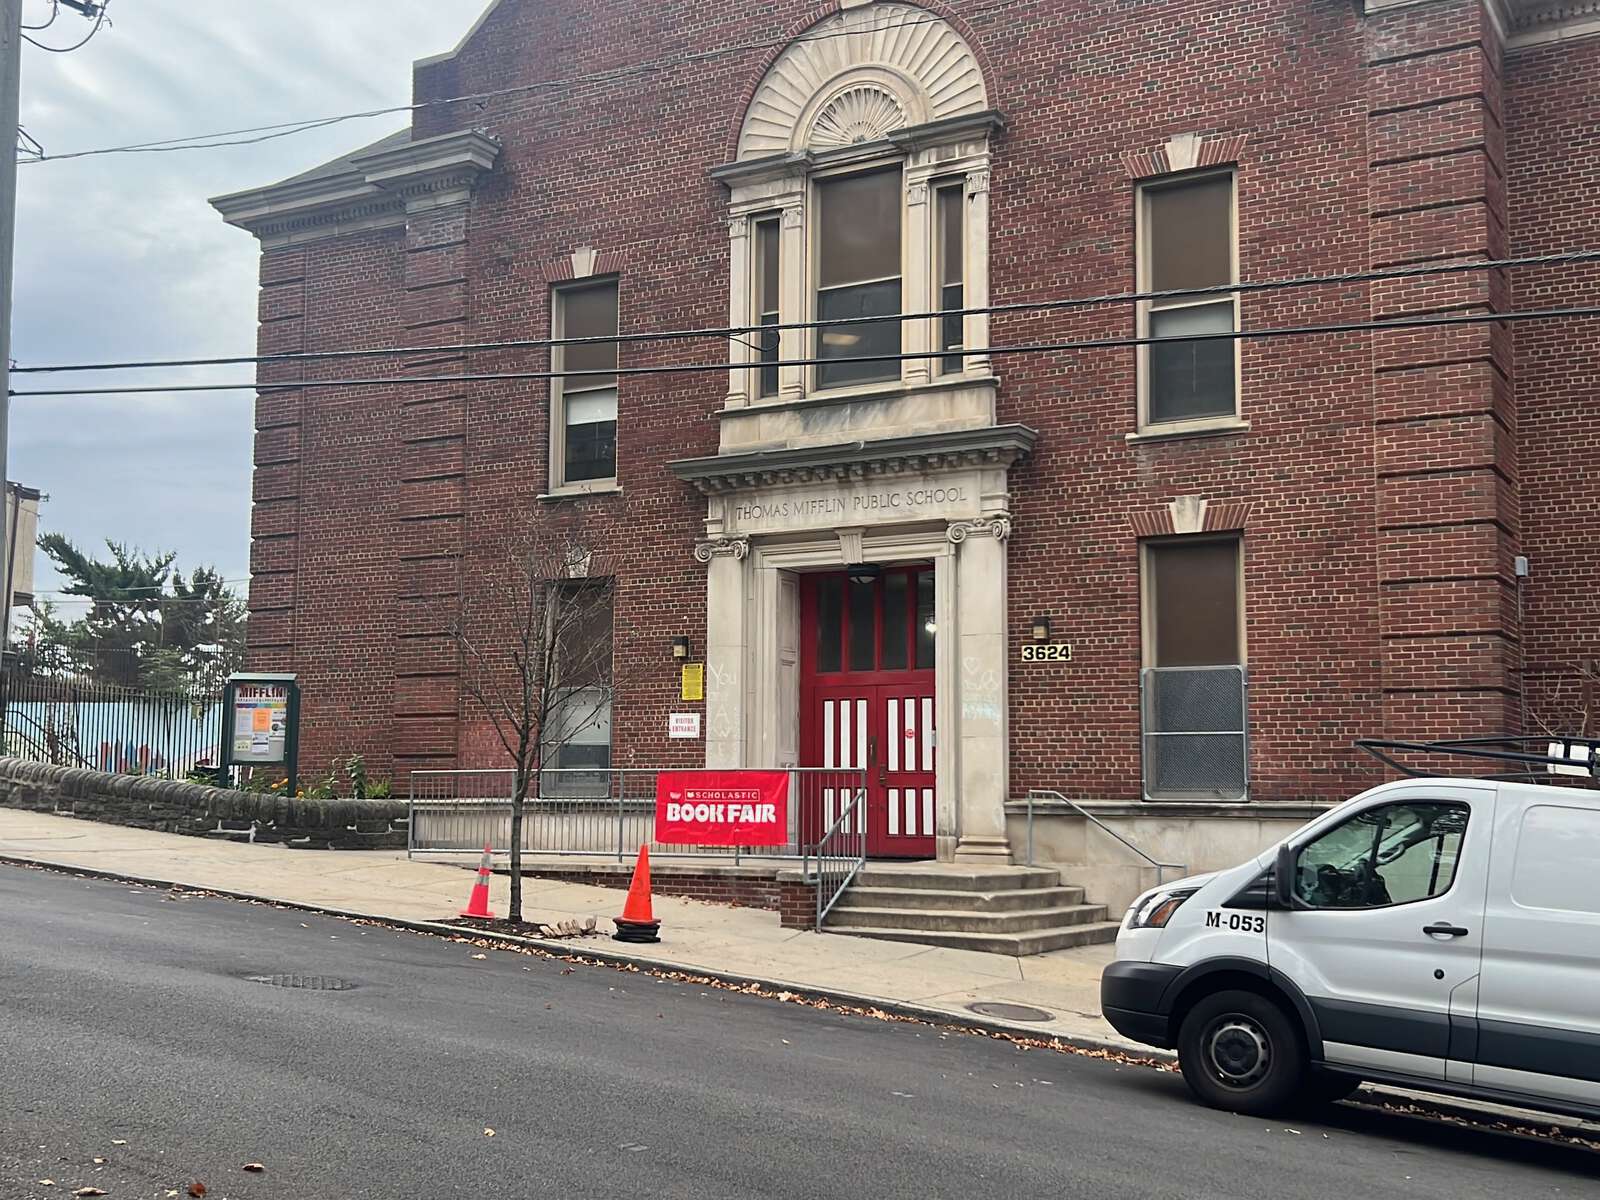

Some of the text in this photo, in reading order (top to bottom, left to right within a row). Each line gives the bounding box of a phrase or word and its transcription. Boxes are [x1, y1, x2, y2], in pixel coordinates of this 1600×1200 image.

[736, 487, 967, 520] THOMAS MIFFLIN PUBLIC SCHOOL
[1023, 645, 1070, 660] 3624
[239, 687, 283, 698] MIFFLIN
[695, 791, 758, 800] SCHOLASTIC
[666, 803, 776, 823] BOOK FAIR
[1205, 911, 1265, 934] M-053
